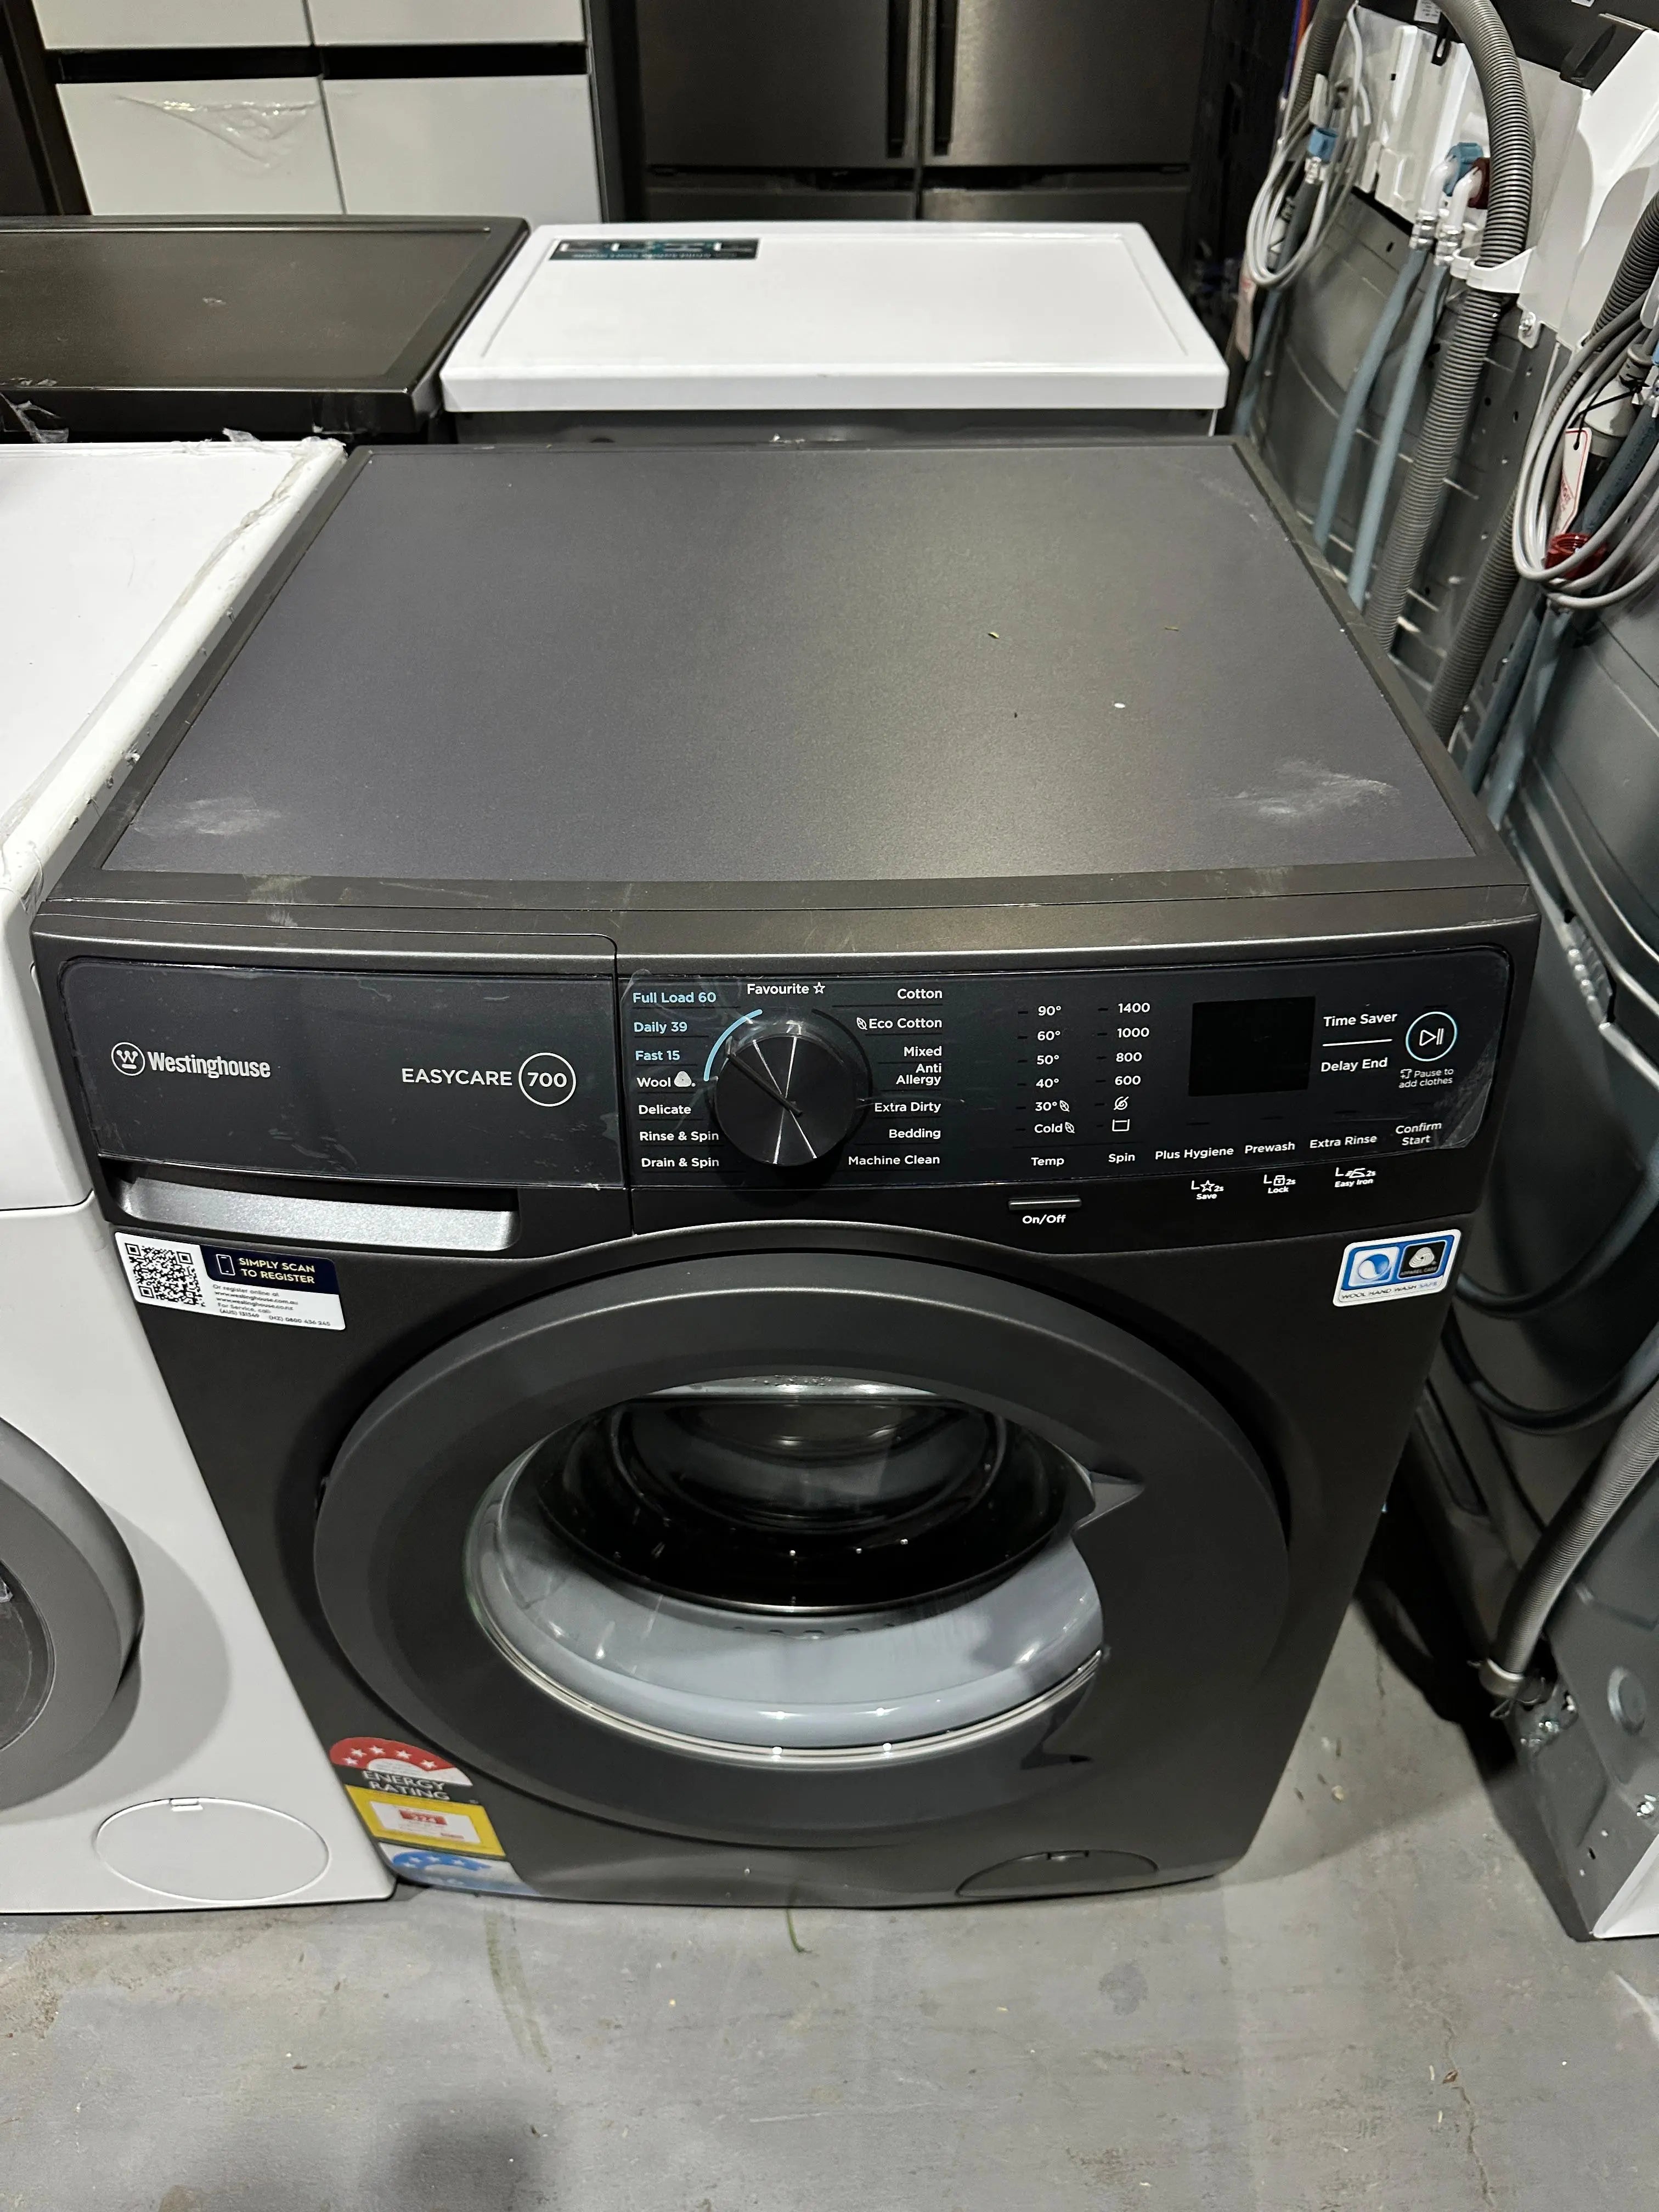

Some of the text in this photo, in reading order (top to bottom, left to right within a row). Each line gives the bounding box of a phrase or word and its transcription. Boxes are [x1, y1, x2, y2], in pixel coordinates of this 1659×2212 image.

[747, 983, 809, 994] Favourite
[898, 989, 942, 999] Cotton
[633, 992, 716, 1005] Full Load 60
[1119, 1003, 1150, 1013] 1400
[870, 1018, 942, 1028] Eco Cotton
[1323, 1014, 1397, 1026] Time Saver
[634, 1022, 687, 1034] Daily 39
[1118, 1028, 1149, 1037] 1000
[636, 1051, 680, 1060] Fast 15
[904, 1046, 941, 1056] Mixed
[1116, 1052, 1142, 1062] 800
[147, 1052, 270, 1078] Westinghouse
[916, 1063, 941, 1073] Anti
[1321, 1057, 1387, 1071] Delay End
[402, 1068, 512, 1085] EASYCARE
[528, 1073, 567, 1087] 700
[636, 1077, 671, 1087] Wool
[896, 1075, 941, 1085] Allergy
[1115, 1076, 1141, 1085] 600
[1399, 1076, 1452, 1088] add clothes
[639, 1104, 691, 1114] Delicate
[875, 1102, 941, 1113] Extra Dirty
[889, 1128, 940, 1139] Bedding
[1035, 1124, 1063, 1133] Cold
[1396, 1123, 1441, 1135] Confirm
[640, 1131, 719, 1142] Rinse & Spin
[1310, 1136, 1377, 1148] Extra Rinse
[1402, 1135, 1430, 1146] Start
[1245, 1142, 1295, 1153] Prewash
[1109, 1153, 1135, 1164] Spin
[1155, 1148, 1234, 1159] Plus Hygiene
[642, 1158, 719, 1168] Drain & Spin
[849, 1155, 940, 1165] Machine Clean
[1031, 1158, 1064, 1166] Temp
[1023, 1215, 1066, 1224] On/Off
[239, 1257, 315, 1273] SIMPLY SCAN
[241, 1268, 315, 1284] TO REGISTER
[362, 1770, 445, 1791] ENERGY
[369, 1781, 450, 1800] RATING
